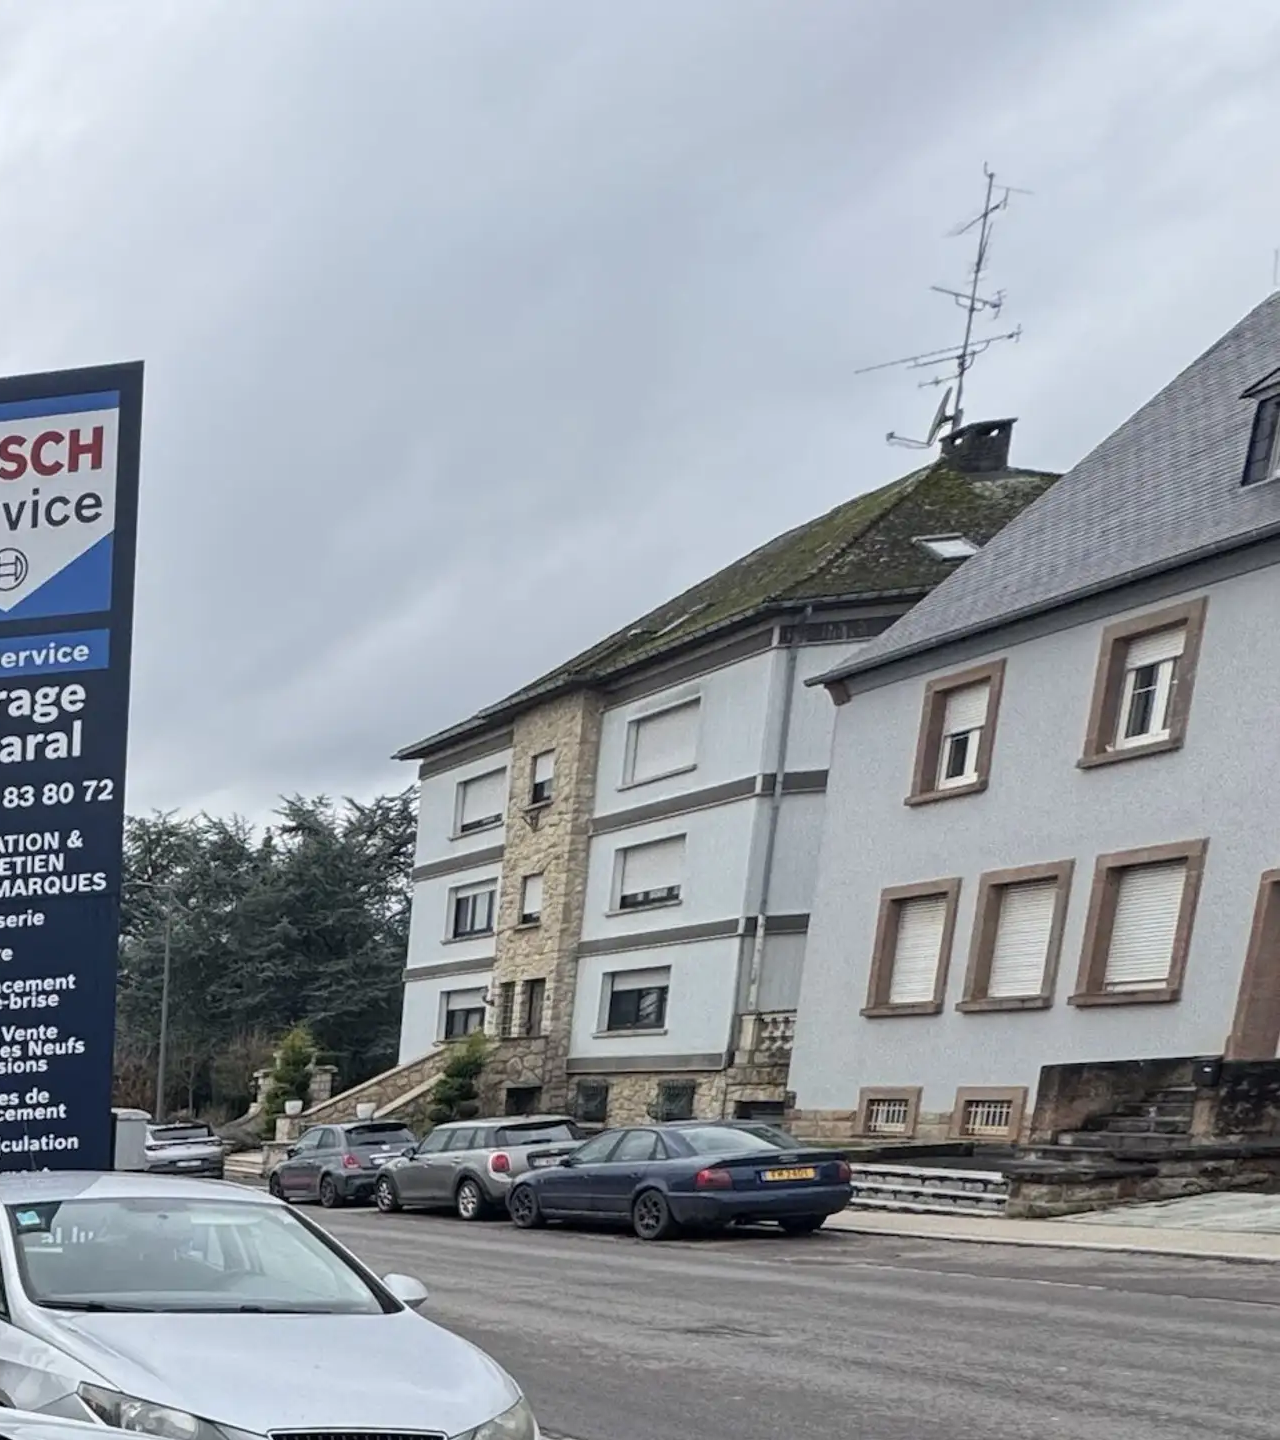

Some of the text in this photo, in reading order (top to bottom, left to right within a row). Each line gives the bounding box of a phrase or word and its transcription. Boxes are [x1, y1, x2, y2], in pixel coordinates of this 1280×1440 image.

[3, 785, 36, 810] 83
[41, 782, 74, 806] 80
[82, 778, 114, 802] 72
[66, 830, 84, 848] &
[1, 1024, 58, 1043] Vente
[28, 1036, 86, 1056] Neufs
[25, 1088, 50, 1105] de
